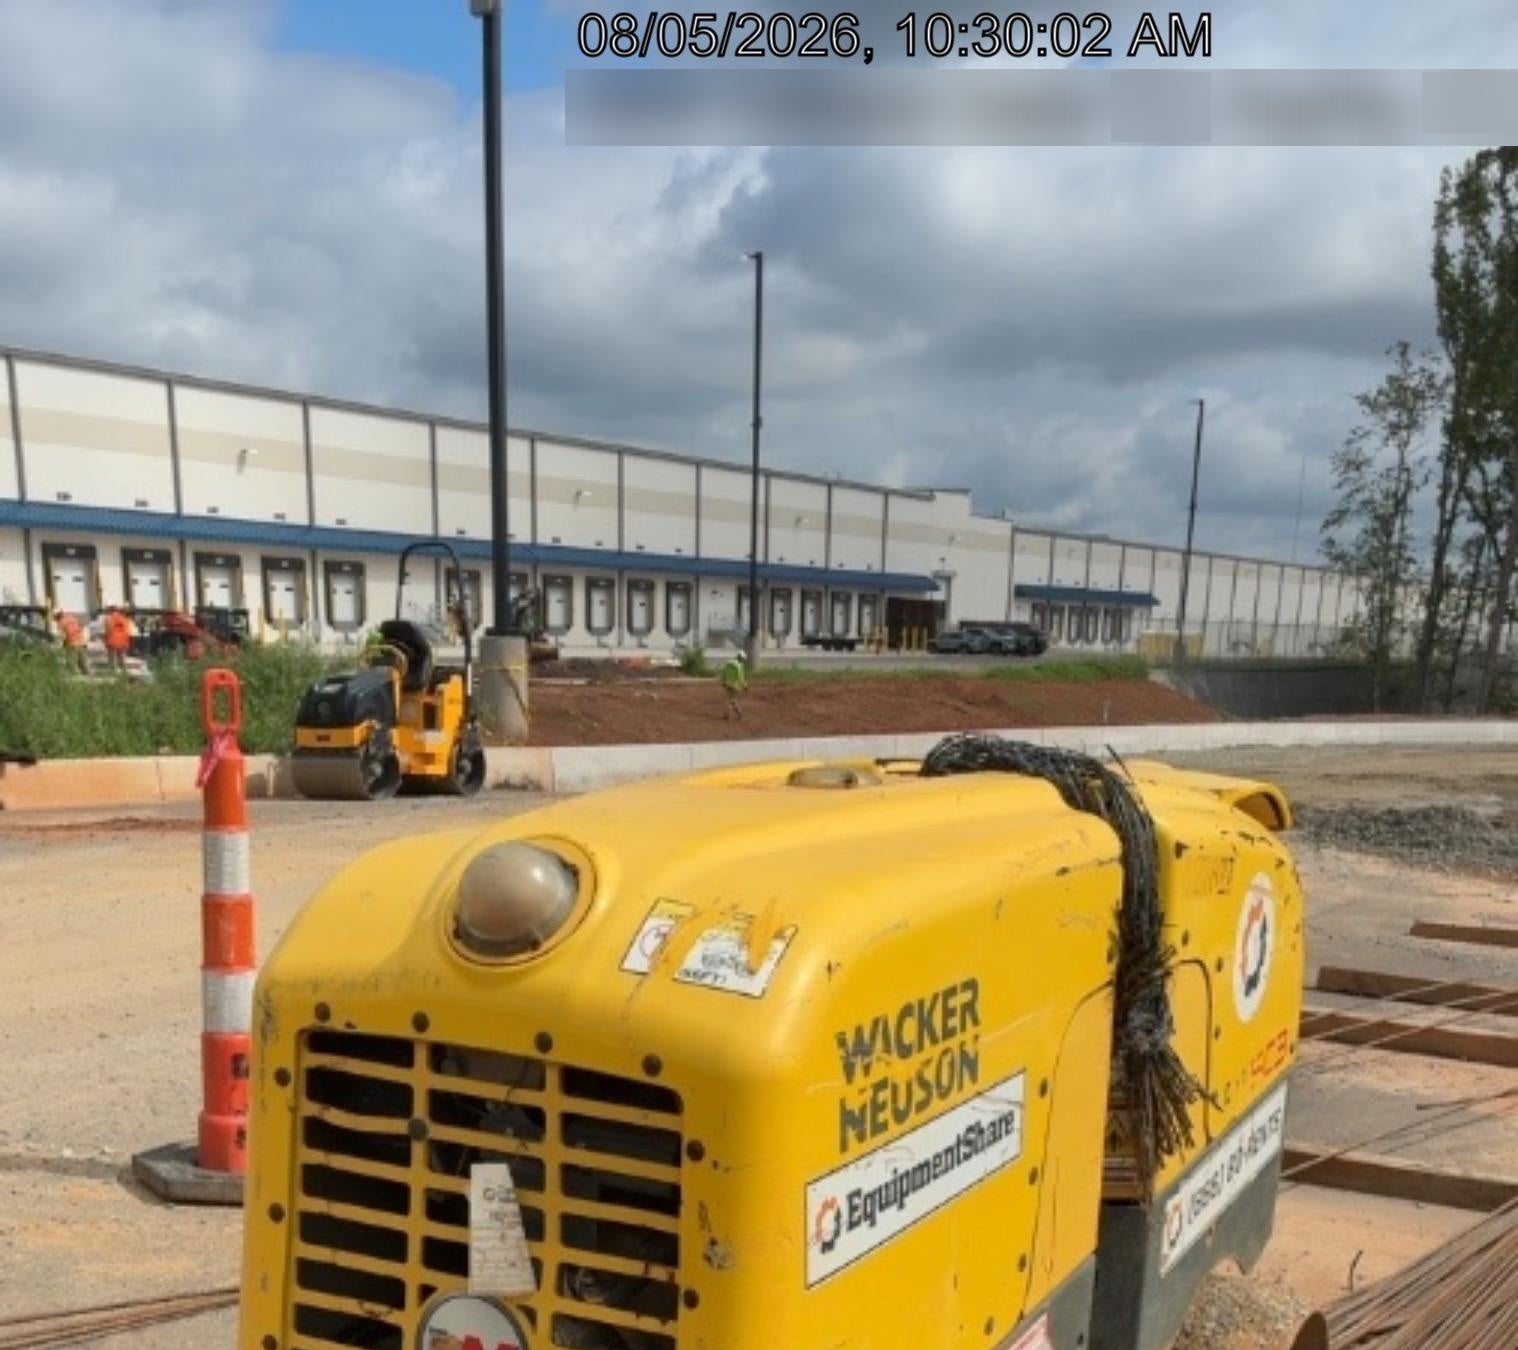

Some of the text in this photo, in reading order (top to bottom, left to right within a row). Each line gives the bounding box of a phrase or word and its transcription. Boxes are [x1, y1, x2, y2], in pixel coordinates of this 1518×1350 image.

[836, 976, 981, 1086] WACKER
[838, 1034, 979, 1153] NEUSON
[845, 1109, 1016, 1232] EquipmentShare
